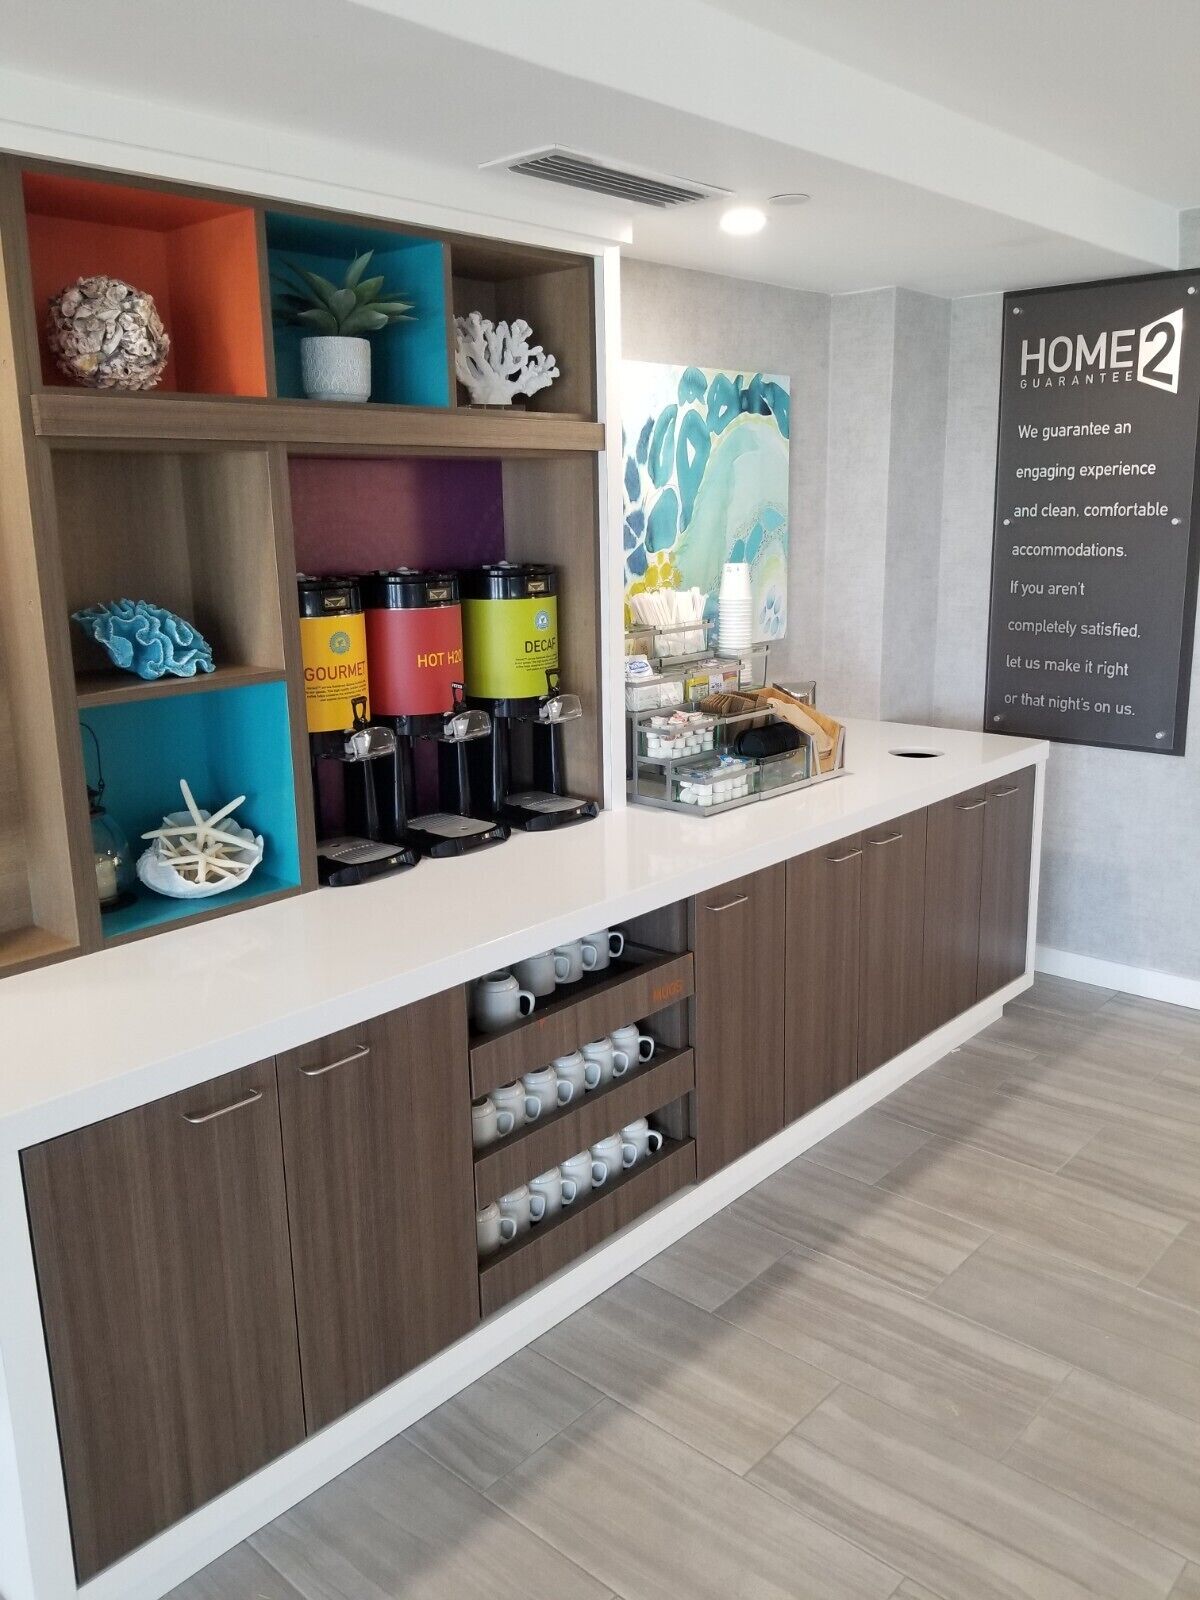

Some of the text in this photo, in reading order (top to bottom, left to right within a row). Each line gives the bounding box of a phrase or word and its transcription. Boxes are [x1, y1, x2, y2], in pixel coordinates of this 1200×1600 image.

[1020, 371, 1134, 389] GUARANTEE
[1018, 422, 1132, 441] We guarantee an
[1016, 461, 1157, 481] engaging experience
[1013, 503, 1038, 518] and
[1084, 502, 1169, 517] comfortable
[1011, 543, 1128, 557] accommodations.
[1009, 580, 1085, 597] If you aren't
[1008, 619, 1141, 639] completely satisfied,
[525, 637, 556, 653] DECAF
[417, 653, 445, 668] HOT
[1006, 655, 1129, 678] let us make it right
[304, 661, 366, 682] GOURMET
[1004, 693, 1136, 716] or that night's on us.
